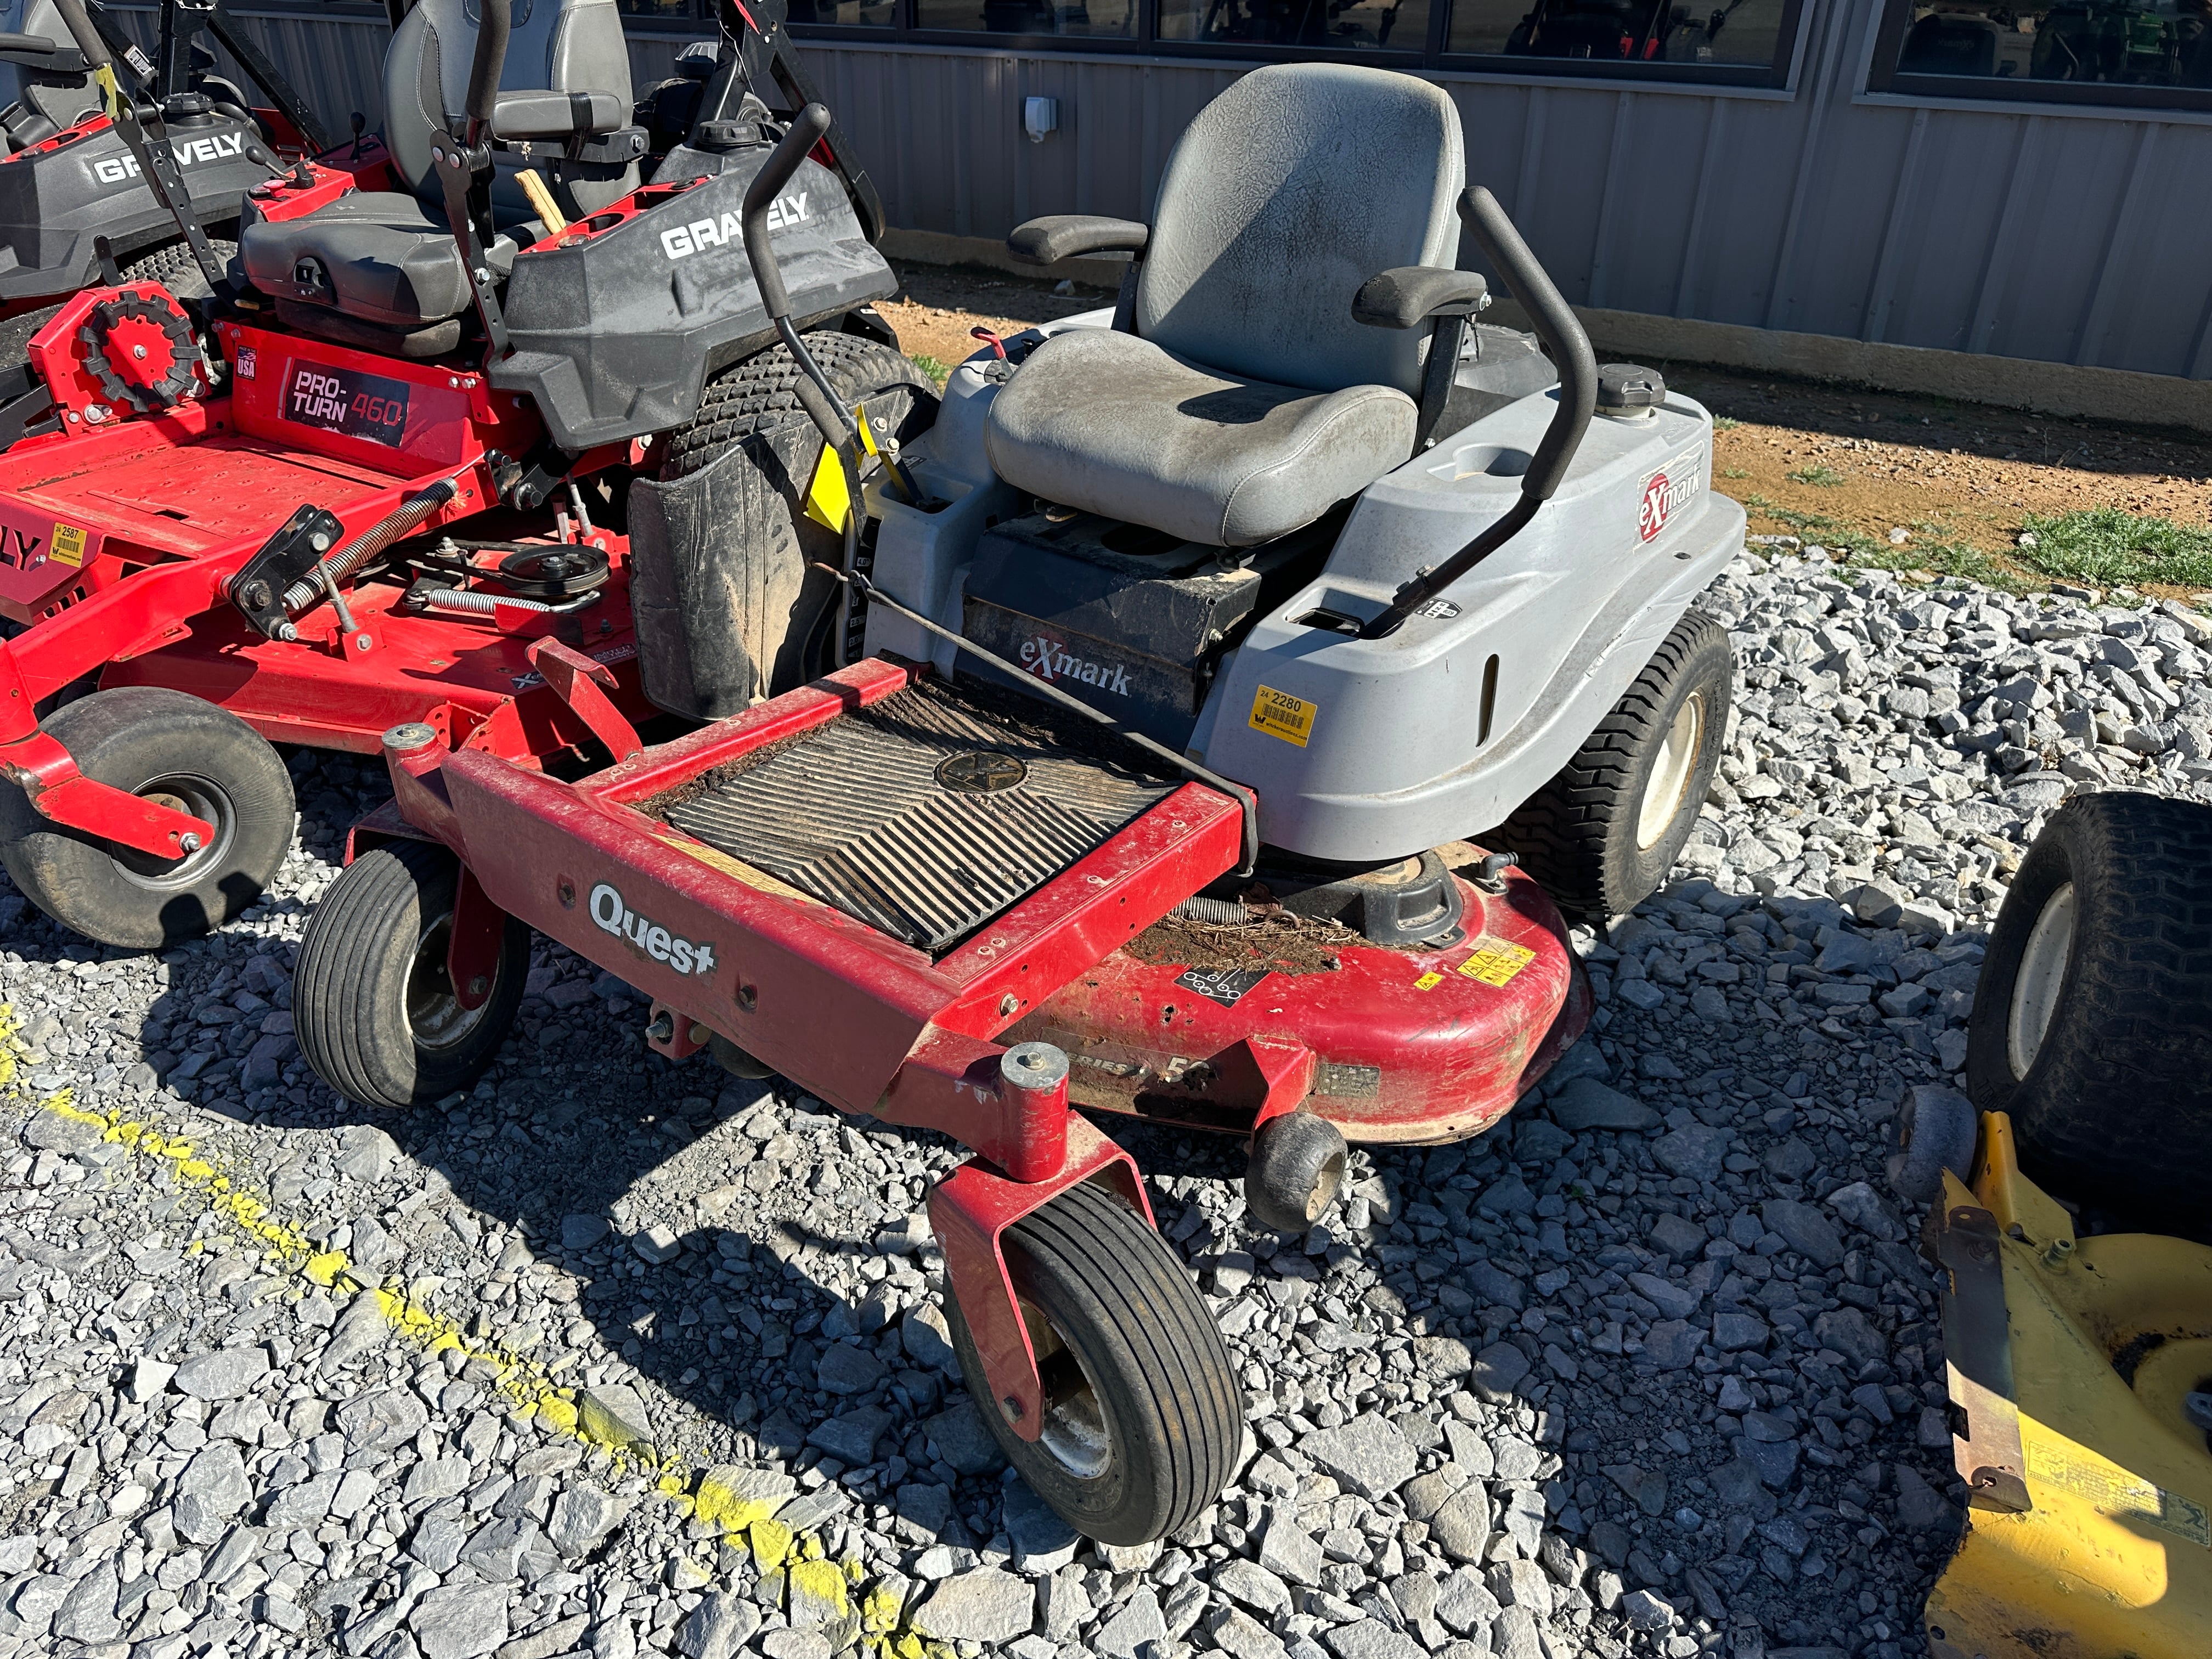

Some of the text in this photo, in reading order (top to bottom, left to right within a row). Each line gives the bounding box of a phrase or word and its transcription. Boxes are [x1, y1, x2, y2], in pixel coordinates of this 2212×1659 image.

[94, 132, 242, 184] GRVELY
[660, 191, 810, 260] GRAELY
[238, 358, 255, 377] USA
[295, 370, 347, 399] PRO-
[294, 391, 402, 426] TURN 460
[1639, 462, 1701, 535] eXmark
[61, 526, 79, 539] 2587
[1019, 636, 1133, 697] eXmark
[1260, 690, 1301, 712] 24 2280
[590, 884, 714, 975] Quest
[1066, 1052, 1211, 1083] ERIES 5
